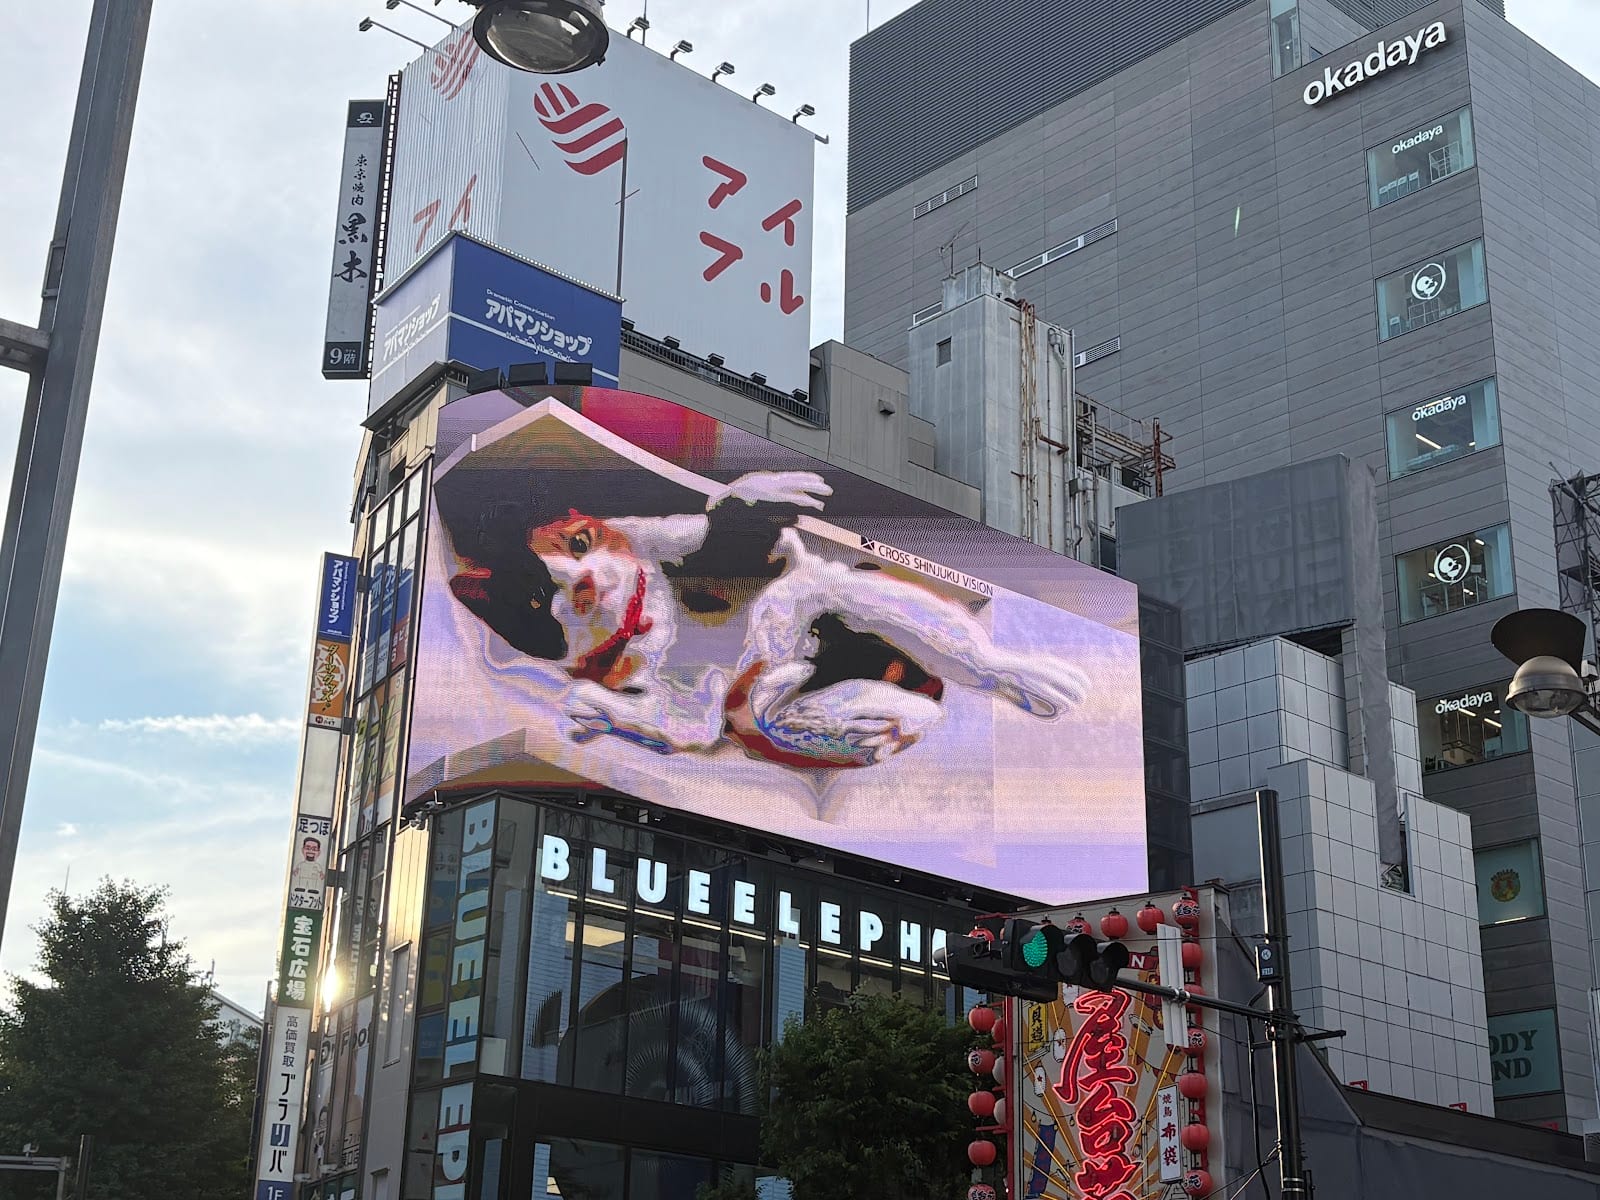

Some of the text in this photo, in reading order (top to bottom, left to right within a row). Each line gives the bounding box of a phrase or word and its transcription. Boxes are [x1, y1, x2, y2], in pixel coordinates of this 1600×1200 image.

[1303, 22, 1448, 105] okadaya
[1391, 124, 1443, 154] okadaya
[335, 153, 368, 282] 東京焼肉 黒木
[383, 293, 441, 361] アパマンショップ
[485, 299, 593, 356] アパマンショップ
[1411, 393, 1467, 421] okadaya
[328, 559, 344, 624] アパマンショップ
[878, 545, 993, 597] CROSS SHINJUKU VISION
[1434, 690, 1493, 715] okadaya
[285, 914, 313, 1001] 宝石広場
[281, 1015, 299, 1068] 高価買取
[269, 1072, 296, 1174] ブラリバ
[1160, 1121, 1178, 1166] 布袋
